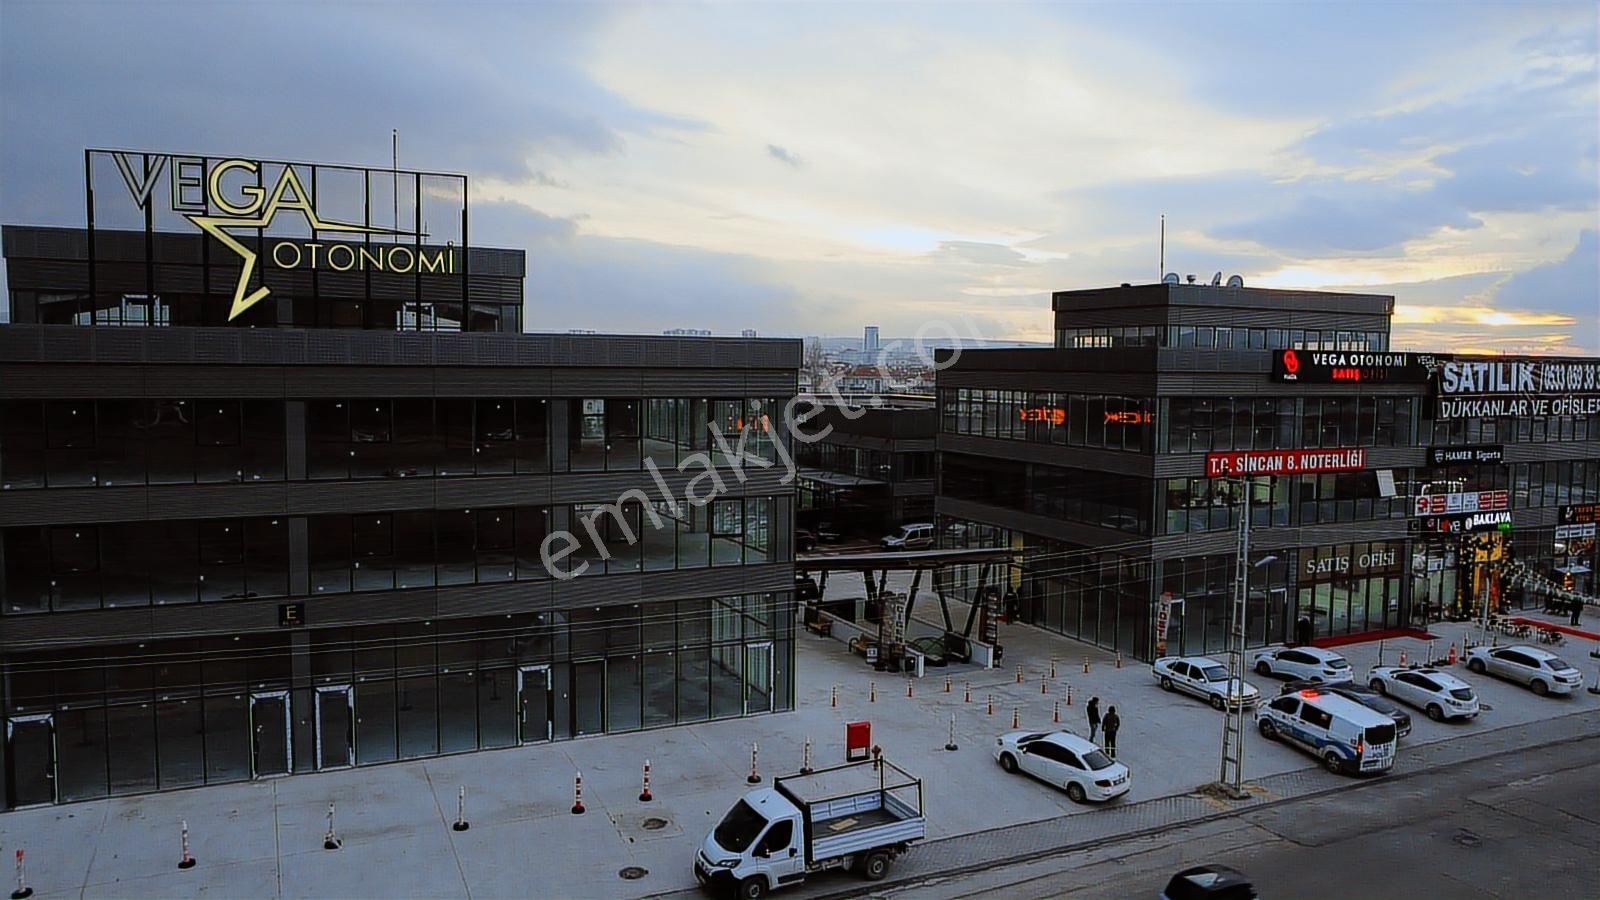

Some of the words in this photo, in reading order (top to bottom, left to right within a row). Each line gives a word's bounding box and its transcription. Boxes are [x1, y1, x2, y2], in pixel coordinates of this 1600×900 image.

[112, 151, 318, 222] VEGA
[273, 240, 455, 275] OTONOMİ
[1312, 353, 1347, 366] VEGA
[1350, 353, 1408, 367] OTONOMİ
[1442, 361, 1536, 393] SATILIK
[1441, 398, 1528, 418] DÜKKANLAR
[1530, 399, 1549, 416] VE
[1236, 453, 1283, 472] SİNCAN
[1287, 455, 1299, 470] 8.
[1300, 449, 1363, 469] NOTERLİĞİ
[1473, 511, 1512, 526] BAKLAVA
[1306, 556, 1350, 574] SATIŞ
[1358, 548, 1396, 568] OFİSİ
[286, 604, 297, 620] E
